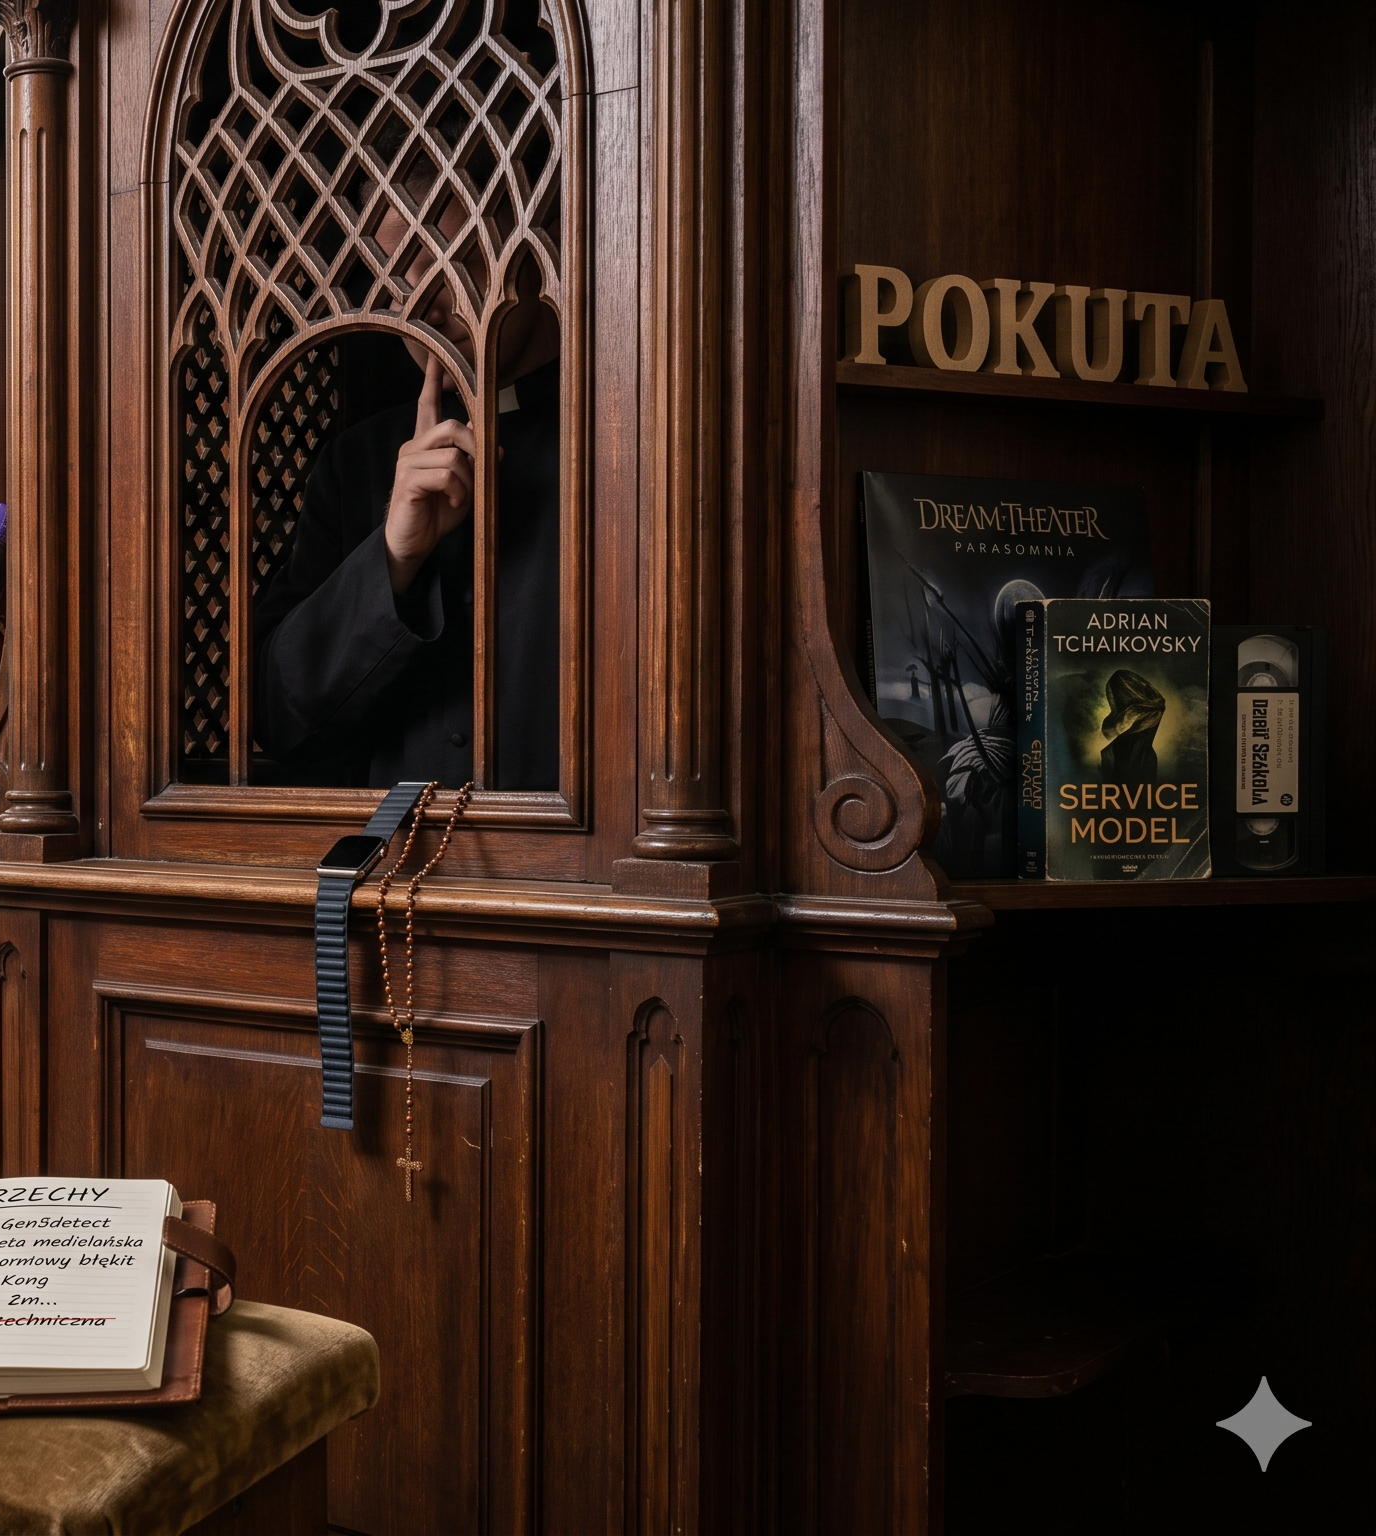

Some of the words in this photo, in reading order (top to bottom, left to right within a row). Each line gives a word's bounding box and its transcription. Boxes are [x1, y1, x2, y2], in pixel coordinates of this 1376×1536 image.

[850, 264, 1249, 393] POKUTA
[913, 498, 1005, 534] DREAM
[1000, 501, 1111, 541] THEATER
[955, 541, 1075, 557] PARASOMNIA
[1086, 613, 1169, 630] ADRIAN
[1052, 635, 1202, 653] TCHAIKOVSKY
[1058, 783, 1200, 810] SERVICE
[1070, 817, 1191, 844] MODEL
[79, 1253, 136, 1268] błękit
[0, 1274, 49, 1289] Kong
[8, 1294, 58, 1306] 2m...
